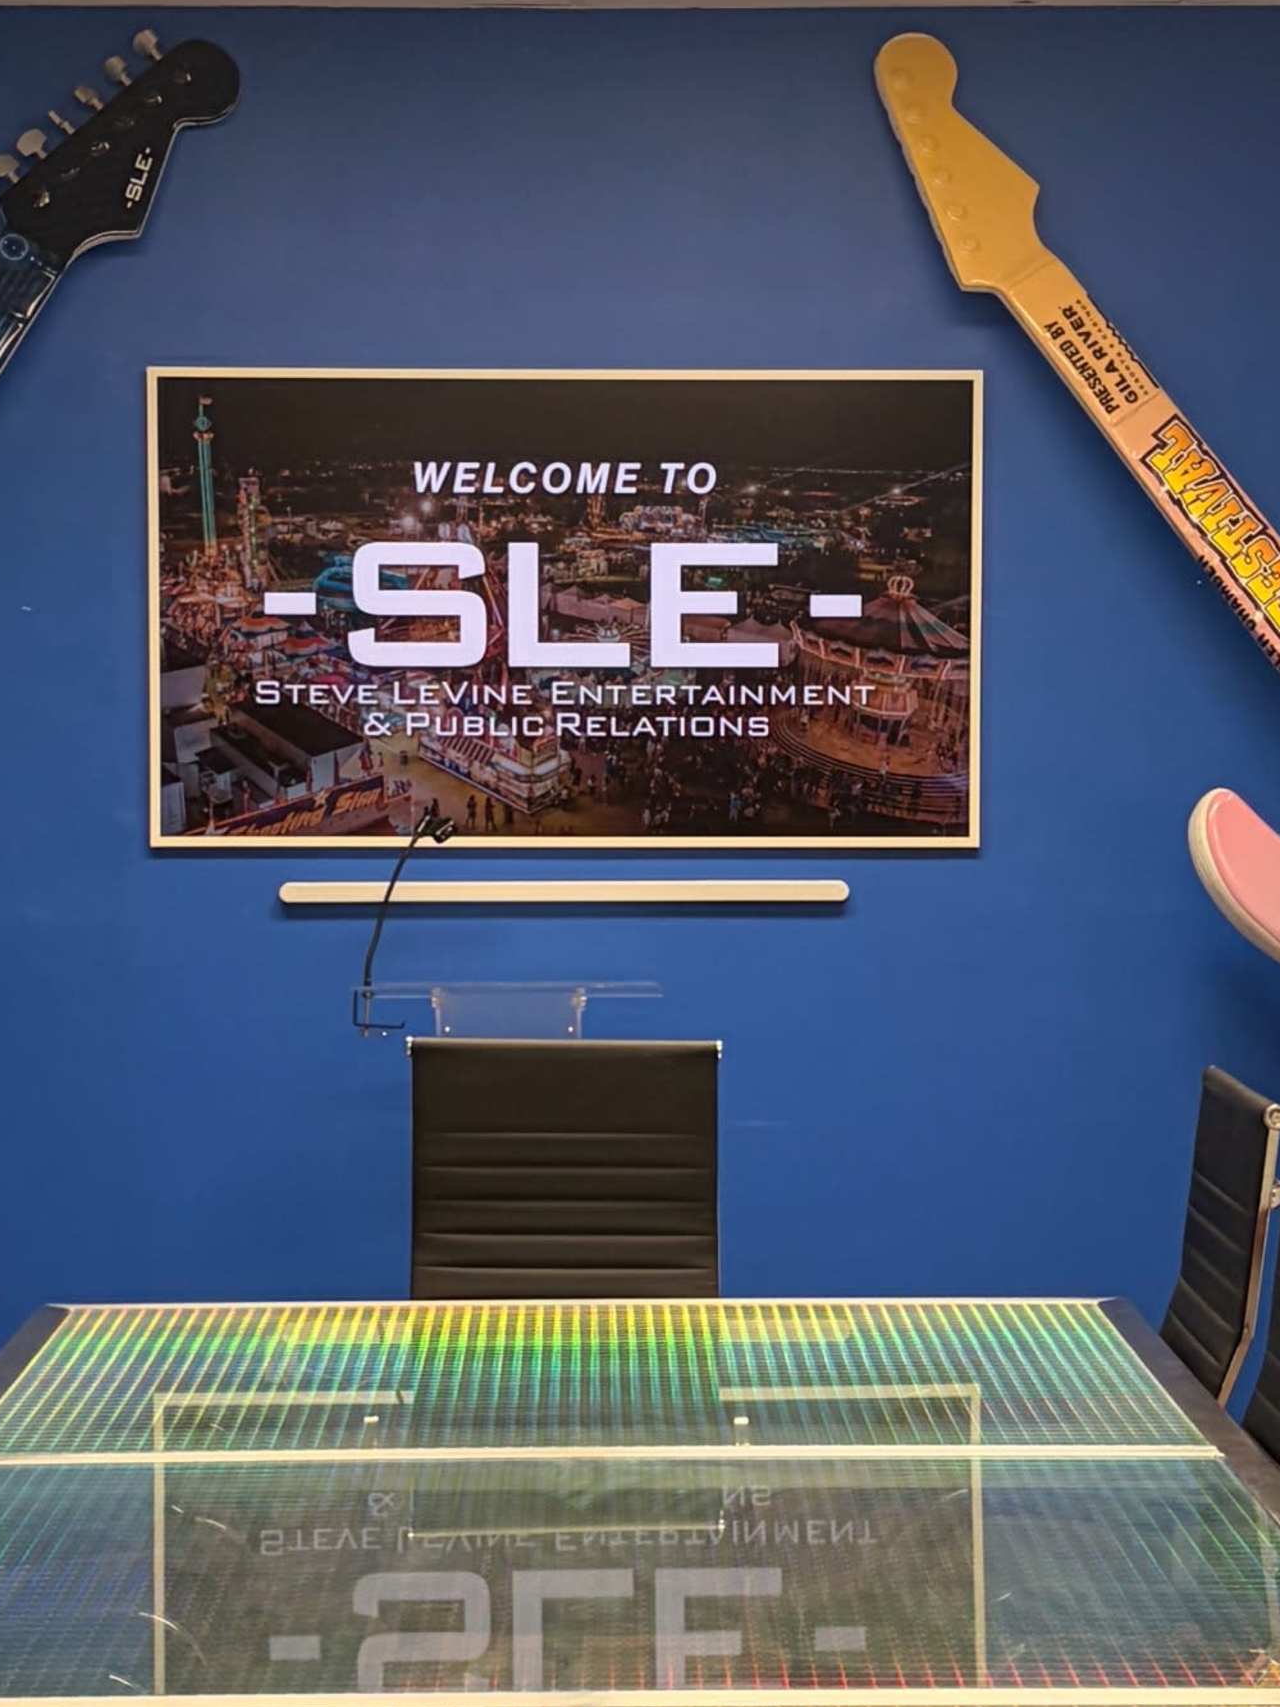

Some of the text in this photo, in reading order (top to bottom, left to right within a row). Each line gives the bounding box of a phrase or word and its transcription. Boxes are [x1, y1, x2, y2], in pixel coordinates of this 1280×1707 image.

[1043, 320, 1121, 415] PRESENTED BY
[1061, 304, 1139, 404] GILA RIVER
[413, 461, 718, 495] WELCOME TO
[254, 680, 378, 706] STEVE
[551, 680, 876, 707] ENTERTAINMENT
[363, 712, 770, 739] & PUBLIC RELATIONS
